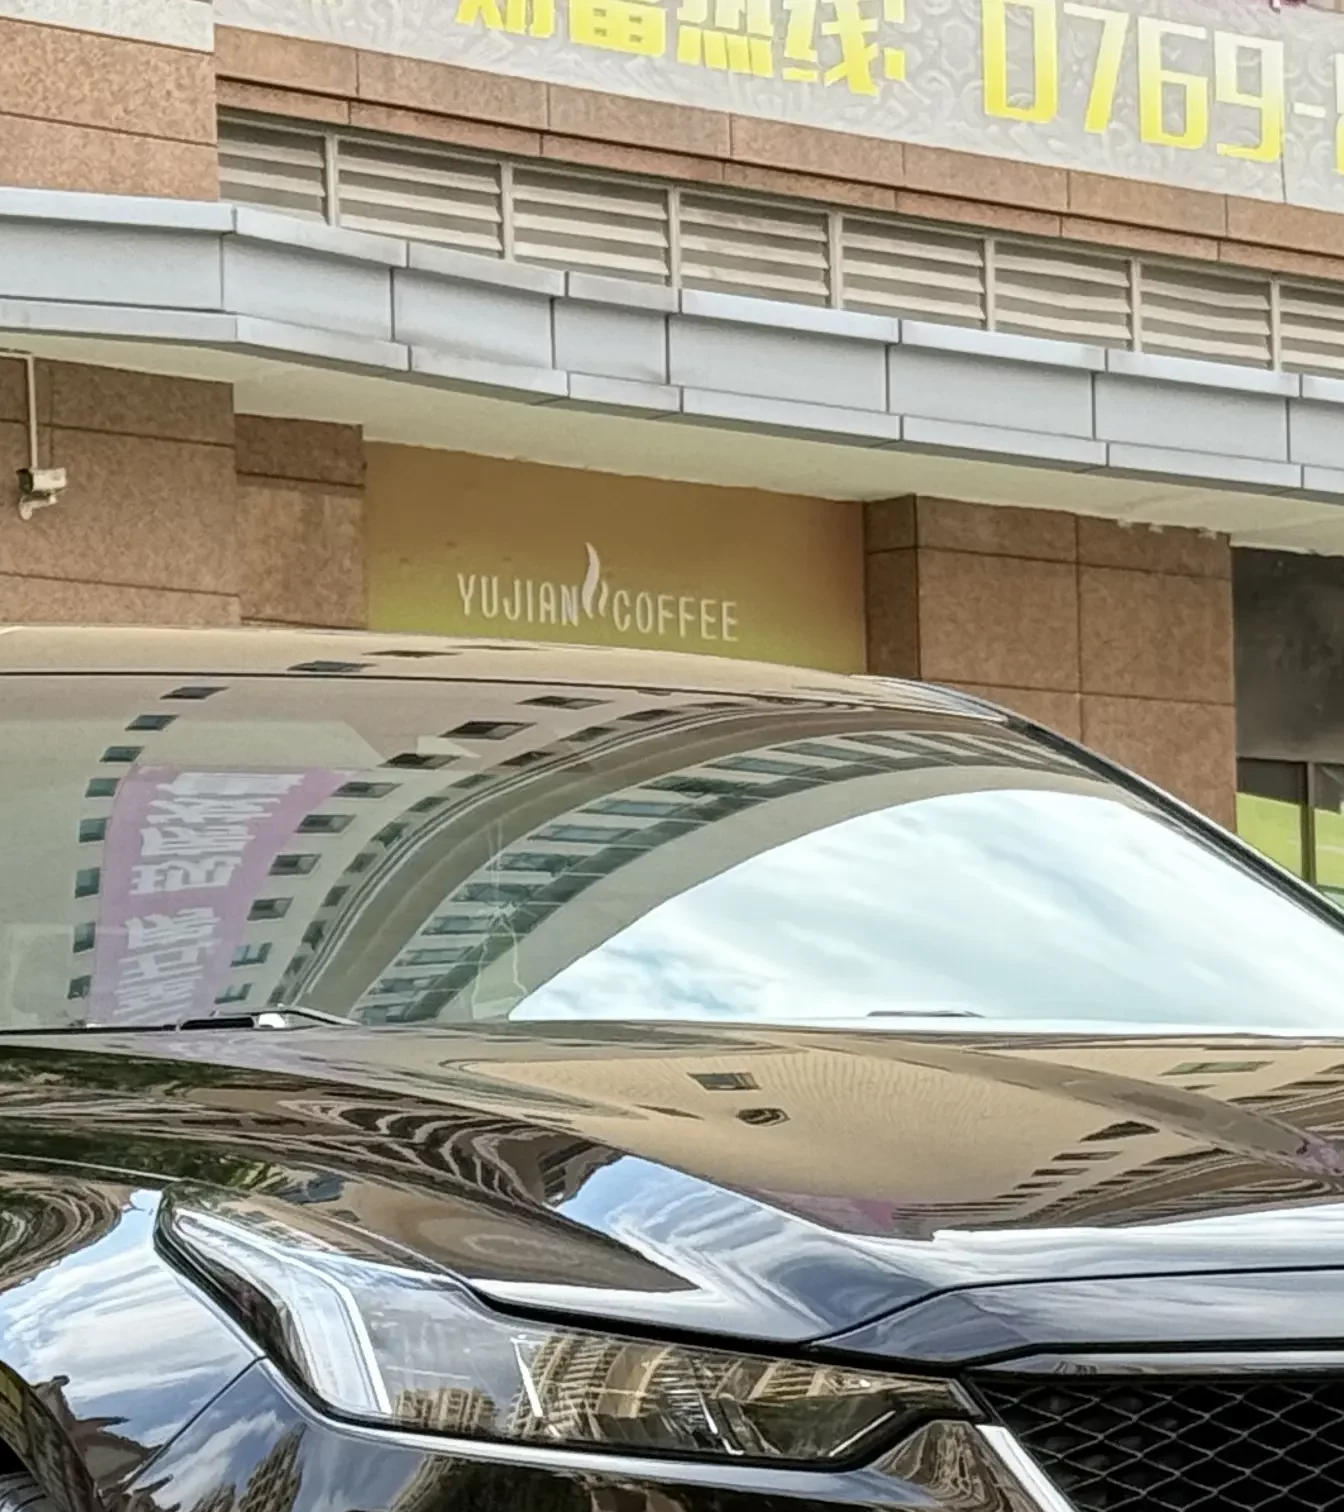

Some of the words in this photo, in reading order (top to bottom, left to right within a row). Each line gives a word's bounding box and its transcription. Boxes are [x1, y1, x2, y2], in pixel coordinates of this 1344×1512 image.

[455, 0, 905, 96] 热线：
[457, 572, 579, 627] YUJIAN
[613, 589, 739, 642] COFFEE
